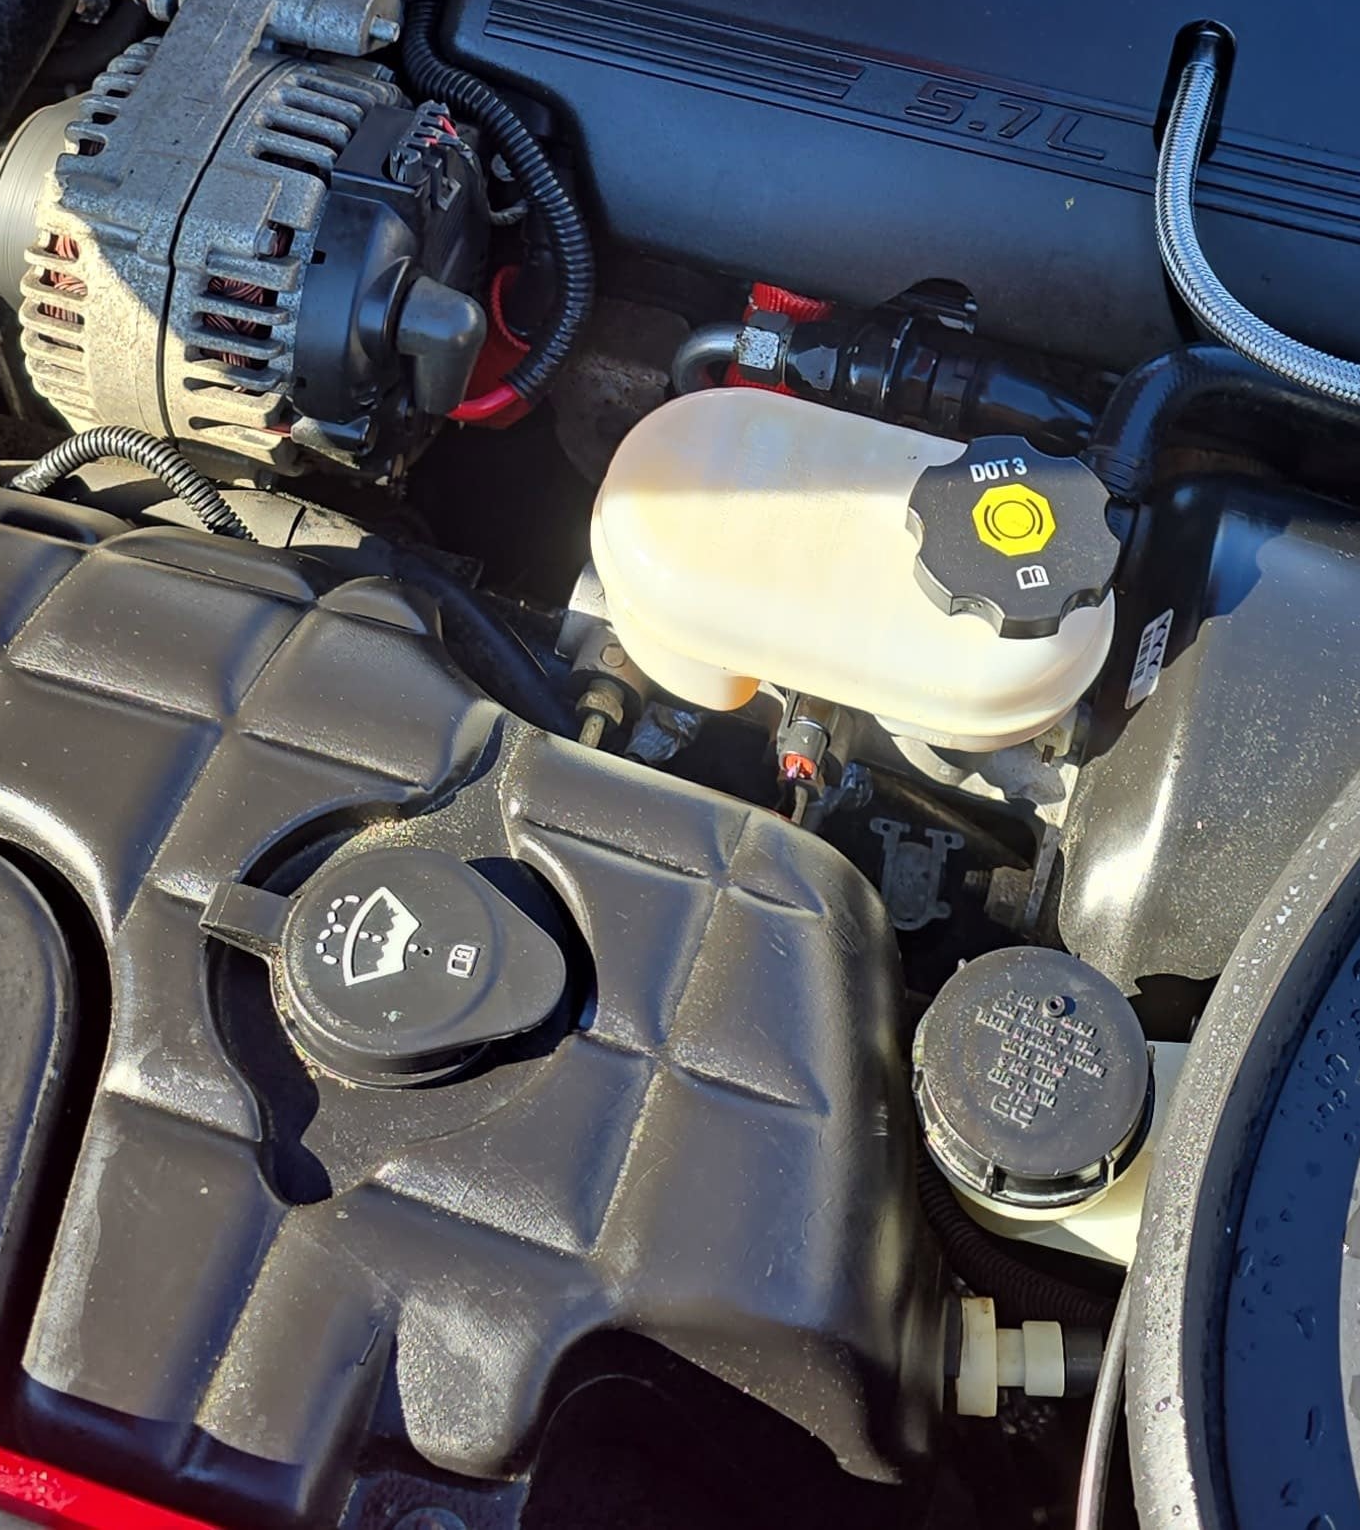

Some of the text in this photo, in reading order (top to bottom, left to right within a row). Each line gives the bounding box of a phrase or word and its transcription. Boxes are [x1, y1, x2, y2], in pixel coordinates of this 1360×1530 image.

[904, 80, 1108, 162] 5.7L
[969, 456, 1028, 484] DOT 3
